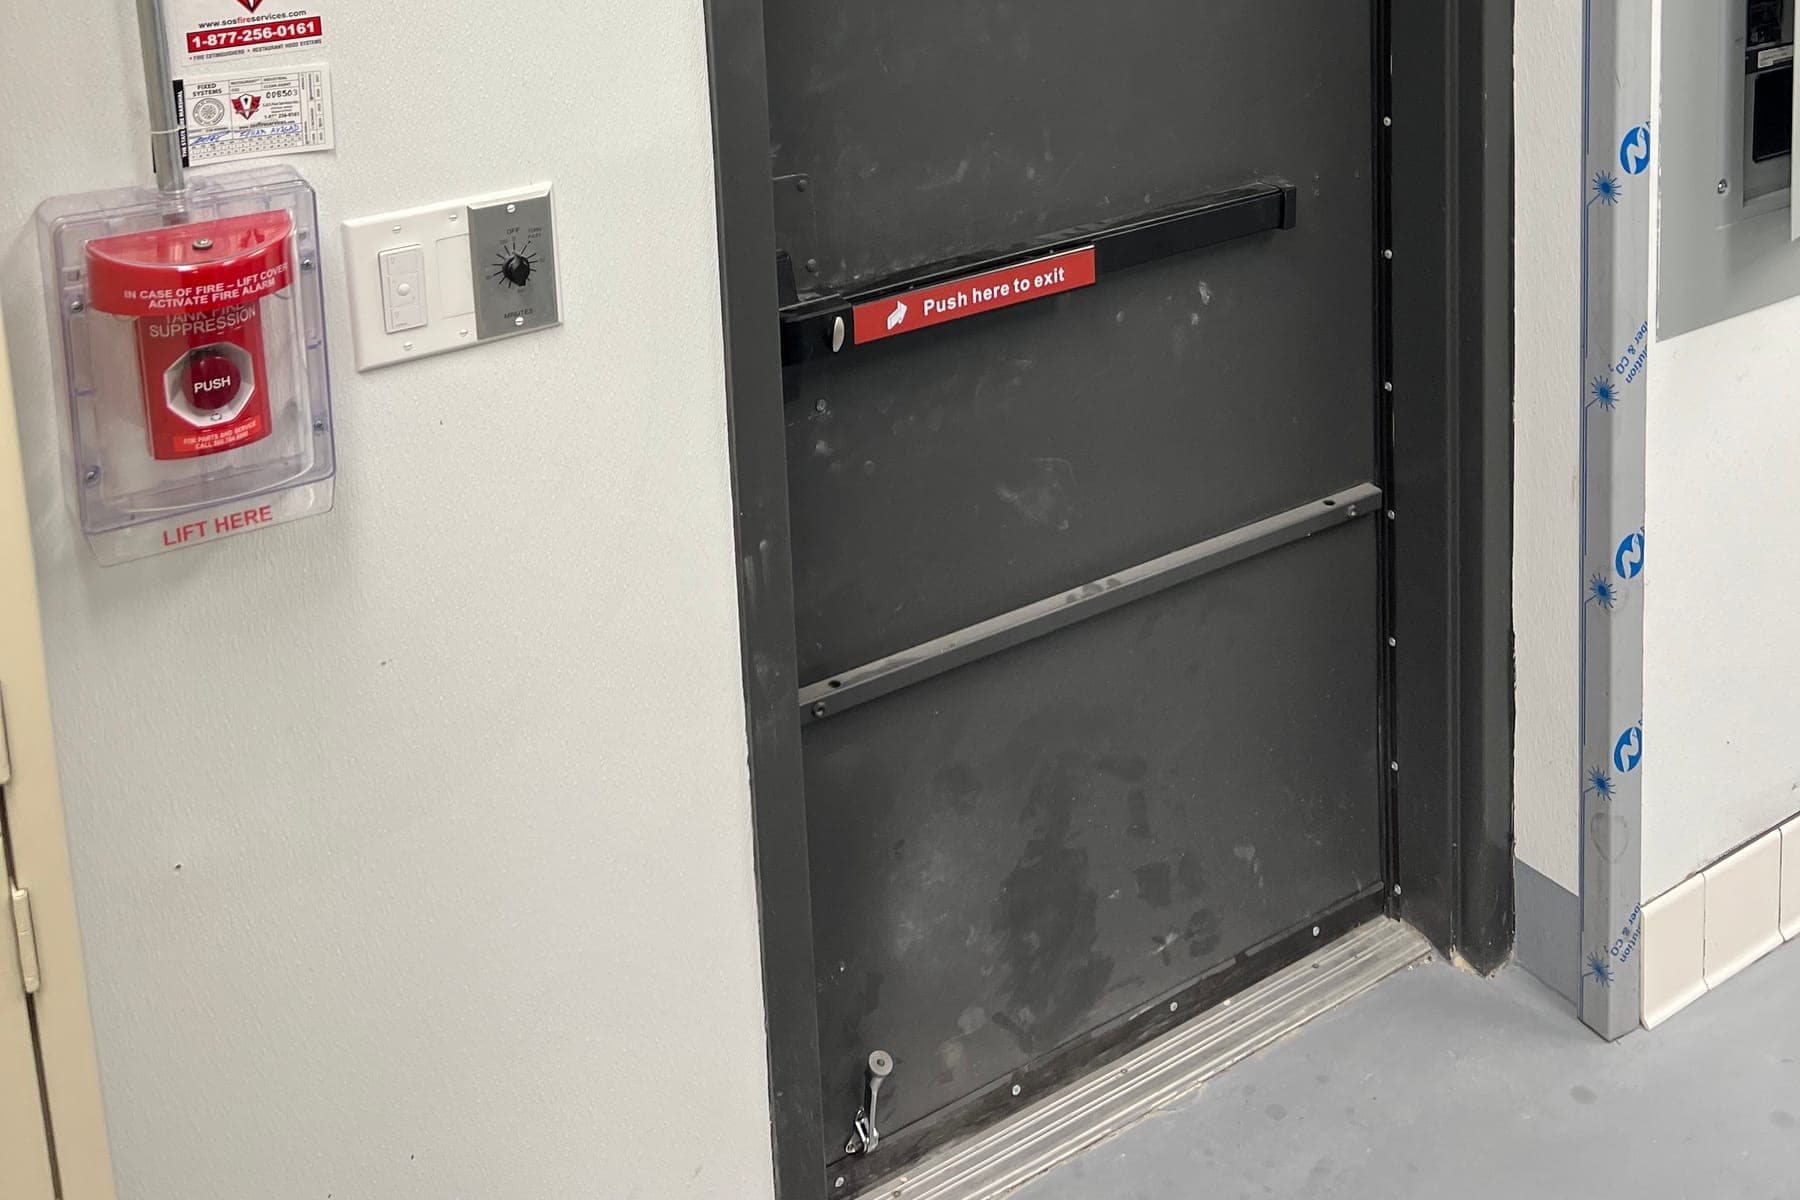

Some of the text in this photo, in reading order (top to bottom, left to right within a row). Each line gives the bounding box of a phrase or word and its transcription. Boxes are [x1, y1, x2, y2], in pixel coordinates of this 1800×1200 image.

[198, 9, 307, 29] www.sosfireservices.com
[192, 21, 315, 48] 1-877-256-0161
[193, 88, 222, 97] SYSTEMS
[506, 227, 520, 235] OFF
[123, 289, 136, 299] IN
[140, 289, 173, 299] CASE
[176, 287, 192, 297] OF
[196, 283, 224, 295] FIRE
[237, 273, 258, 288] LIFT
[260, 262, 288, 280] COVER
[148, 277, 275, 309] ACTIVATE FIRE ALARM
[923, 267, 1065, 316] Push here to exit
[150, 304, 256, 337] SUPPRESSION
[194, 375, 231, 393] PUSH
[163, 505, 273, 546] LIFT HERE
